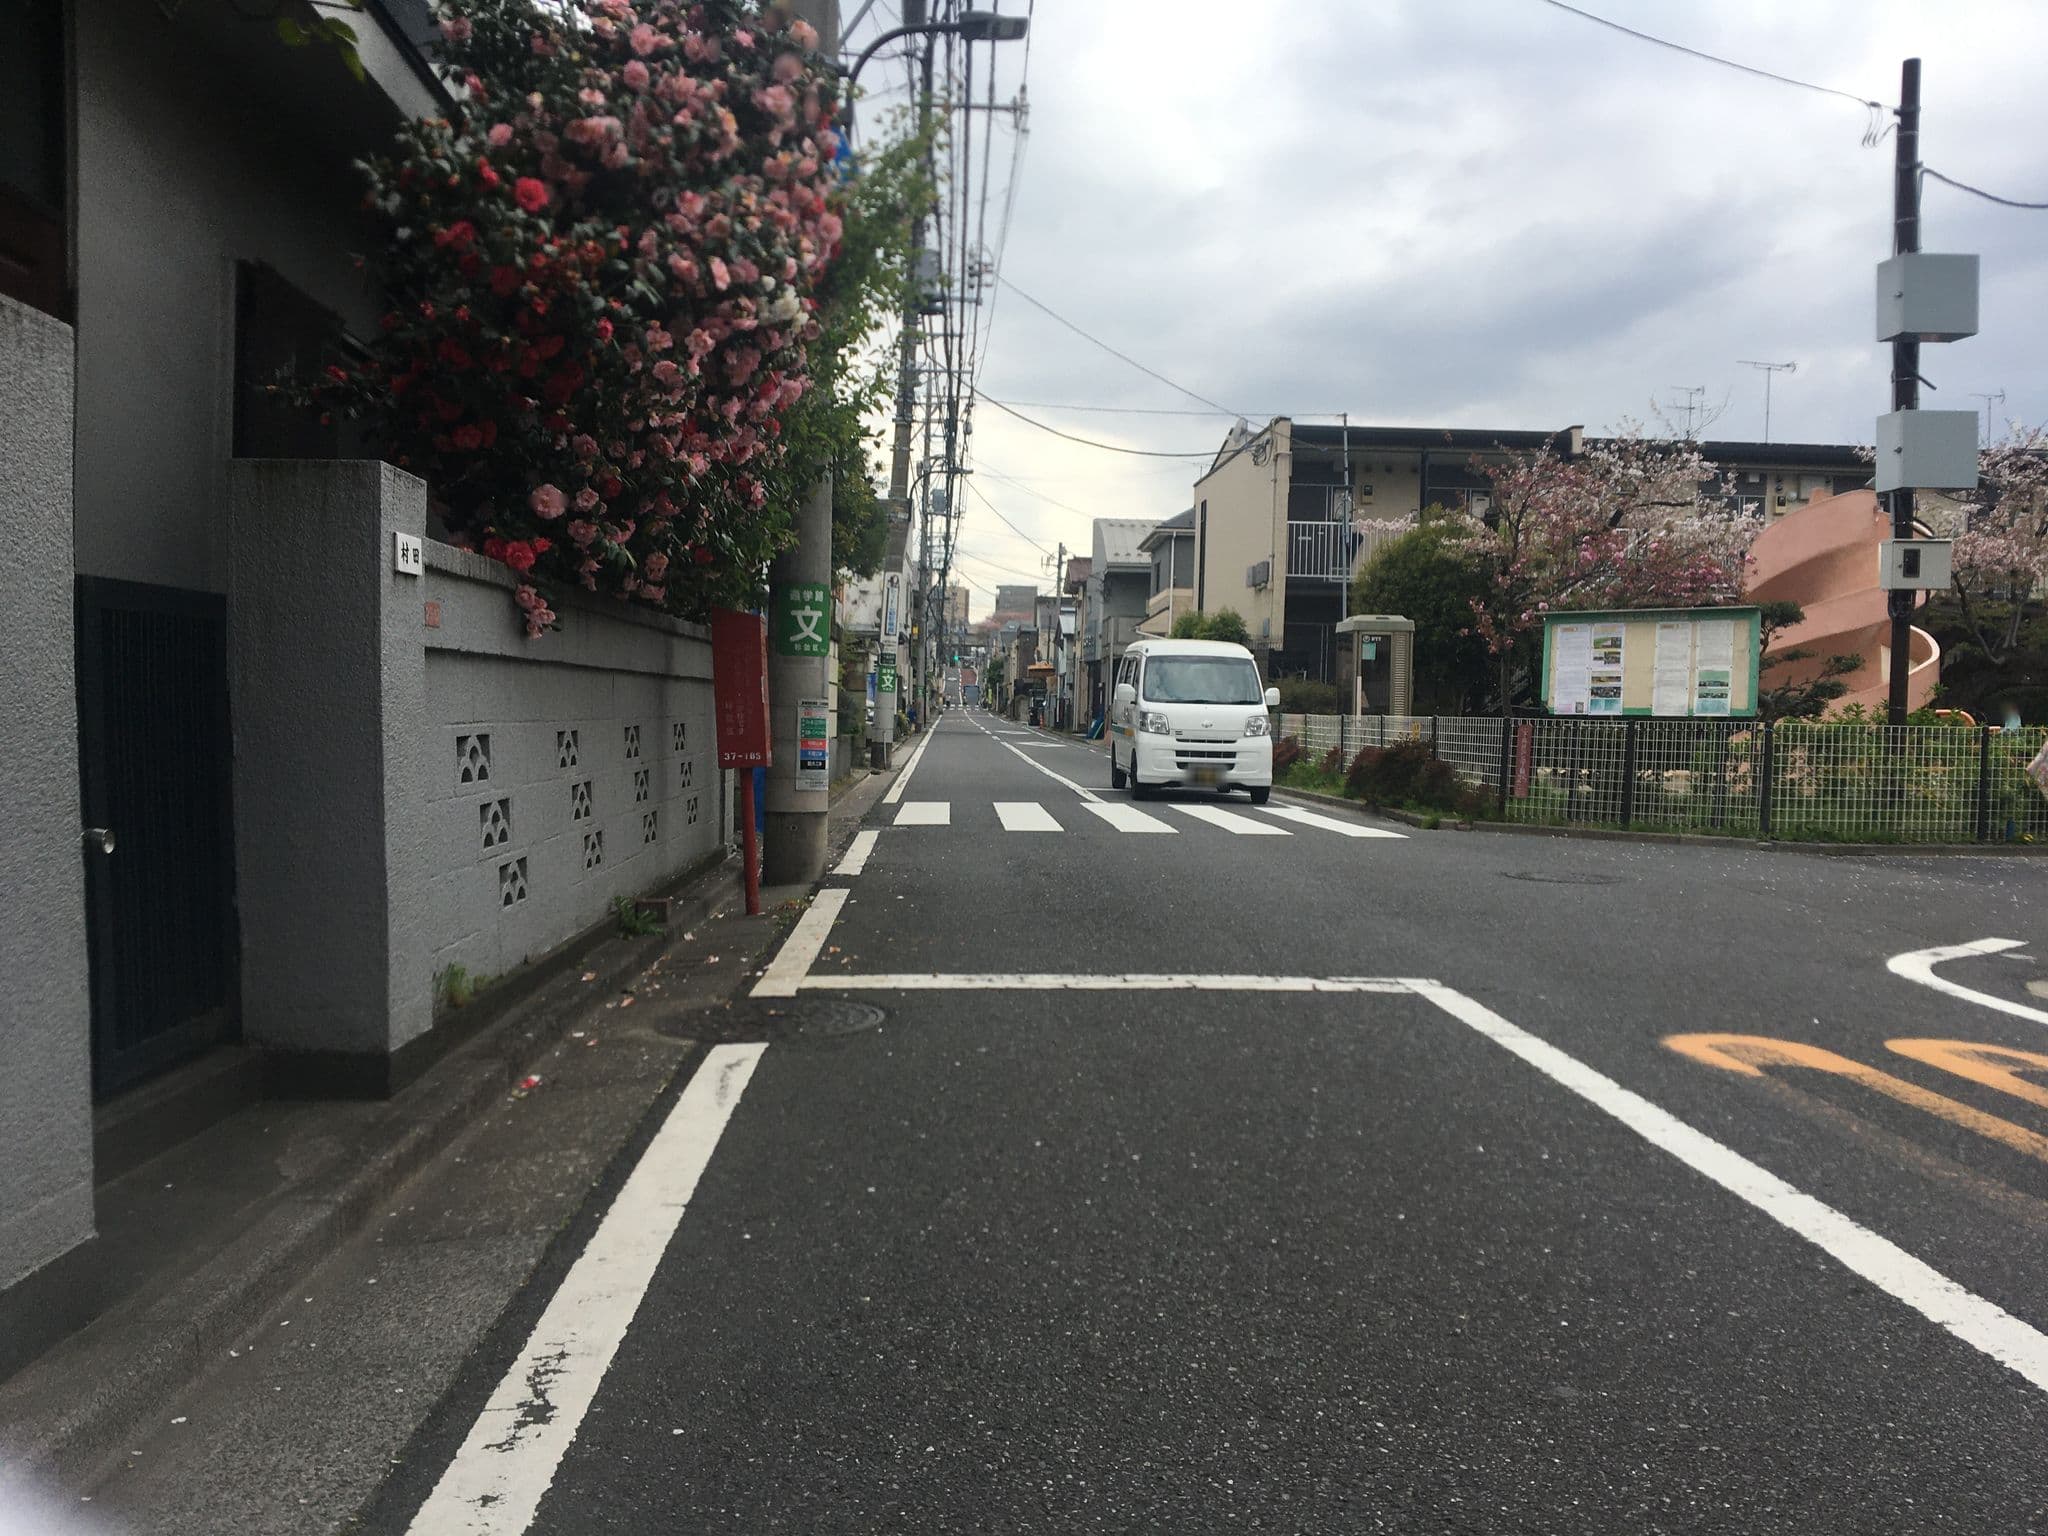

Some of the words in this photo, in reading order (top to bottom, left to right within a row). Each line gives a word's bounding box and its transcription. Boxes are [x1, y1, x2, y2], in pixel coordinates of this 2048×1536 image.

[401, 541, 419, 564] 村田
[790, 605, 823, 642] 文
[881, 675, 894, 688] 文
